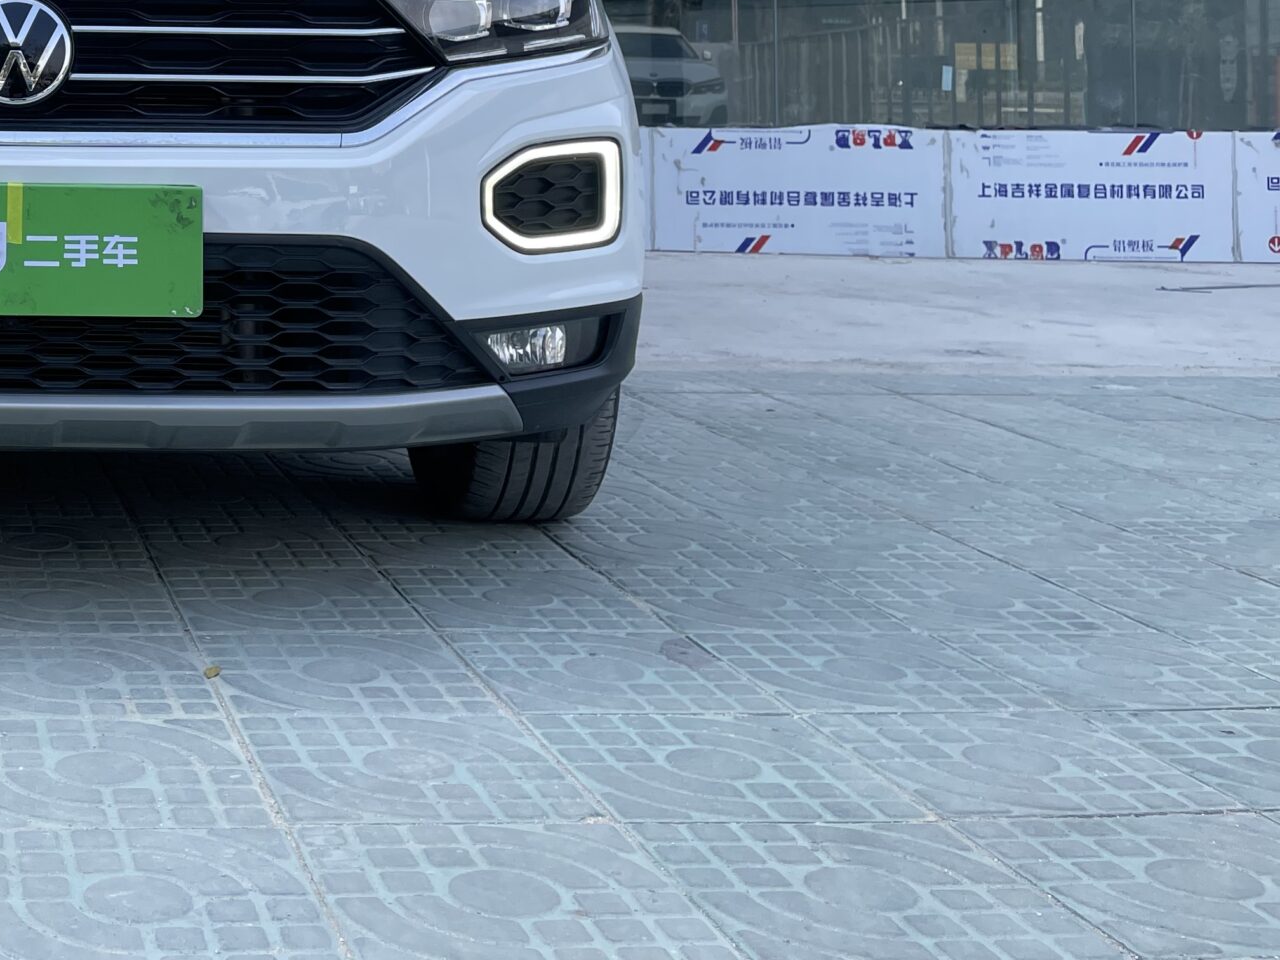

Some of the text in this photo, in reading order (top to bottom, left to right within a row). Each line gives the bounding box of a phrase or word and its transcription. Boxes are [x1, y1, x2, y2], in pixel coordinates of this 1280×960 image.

[685, 190, 919, 208] 上海吉祥金属复合材料有限公司
[978, 182, 1205, 200] 上海吉祥金属复合材料有限公司
[24, 234, 139, 268] 二手车
